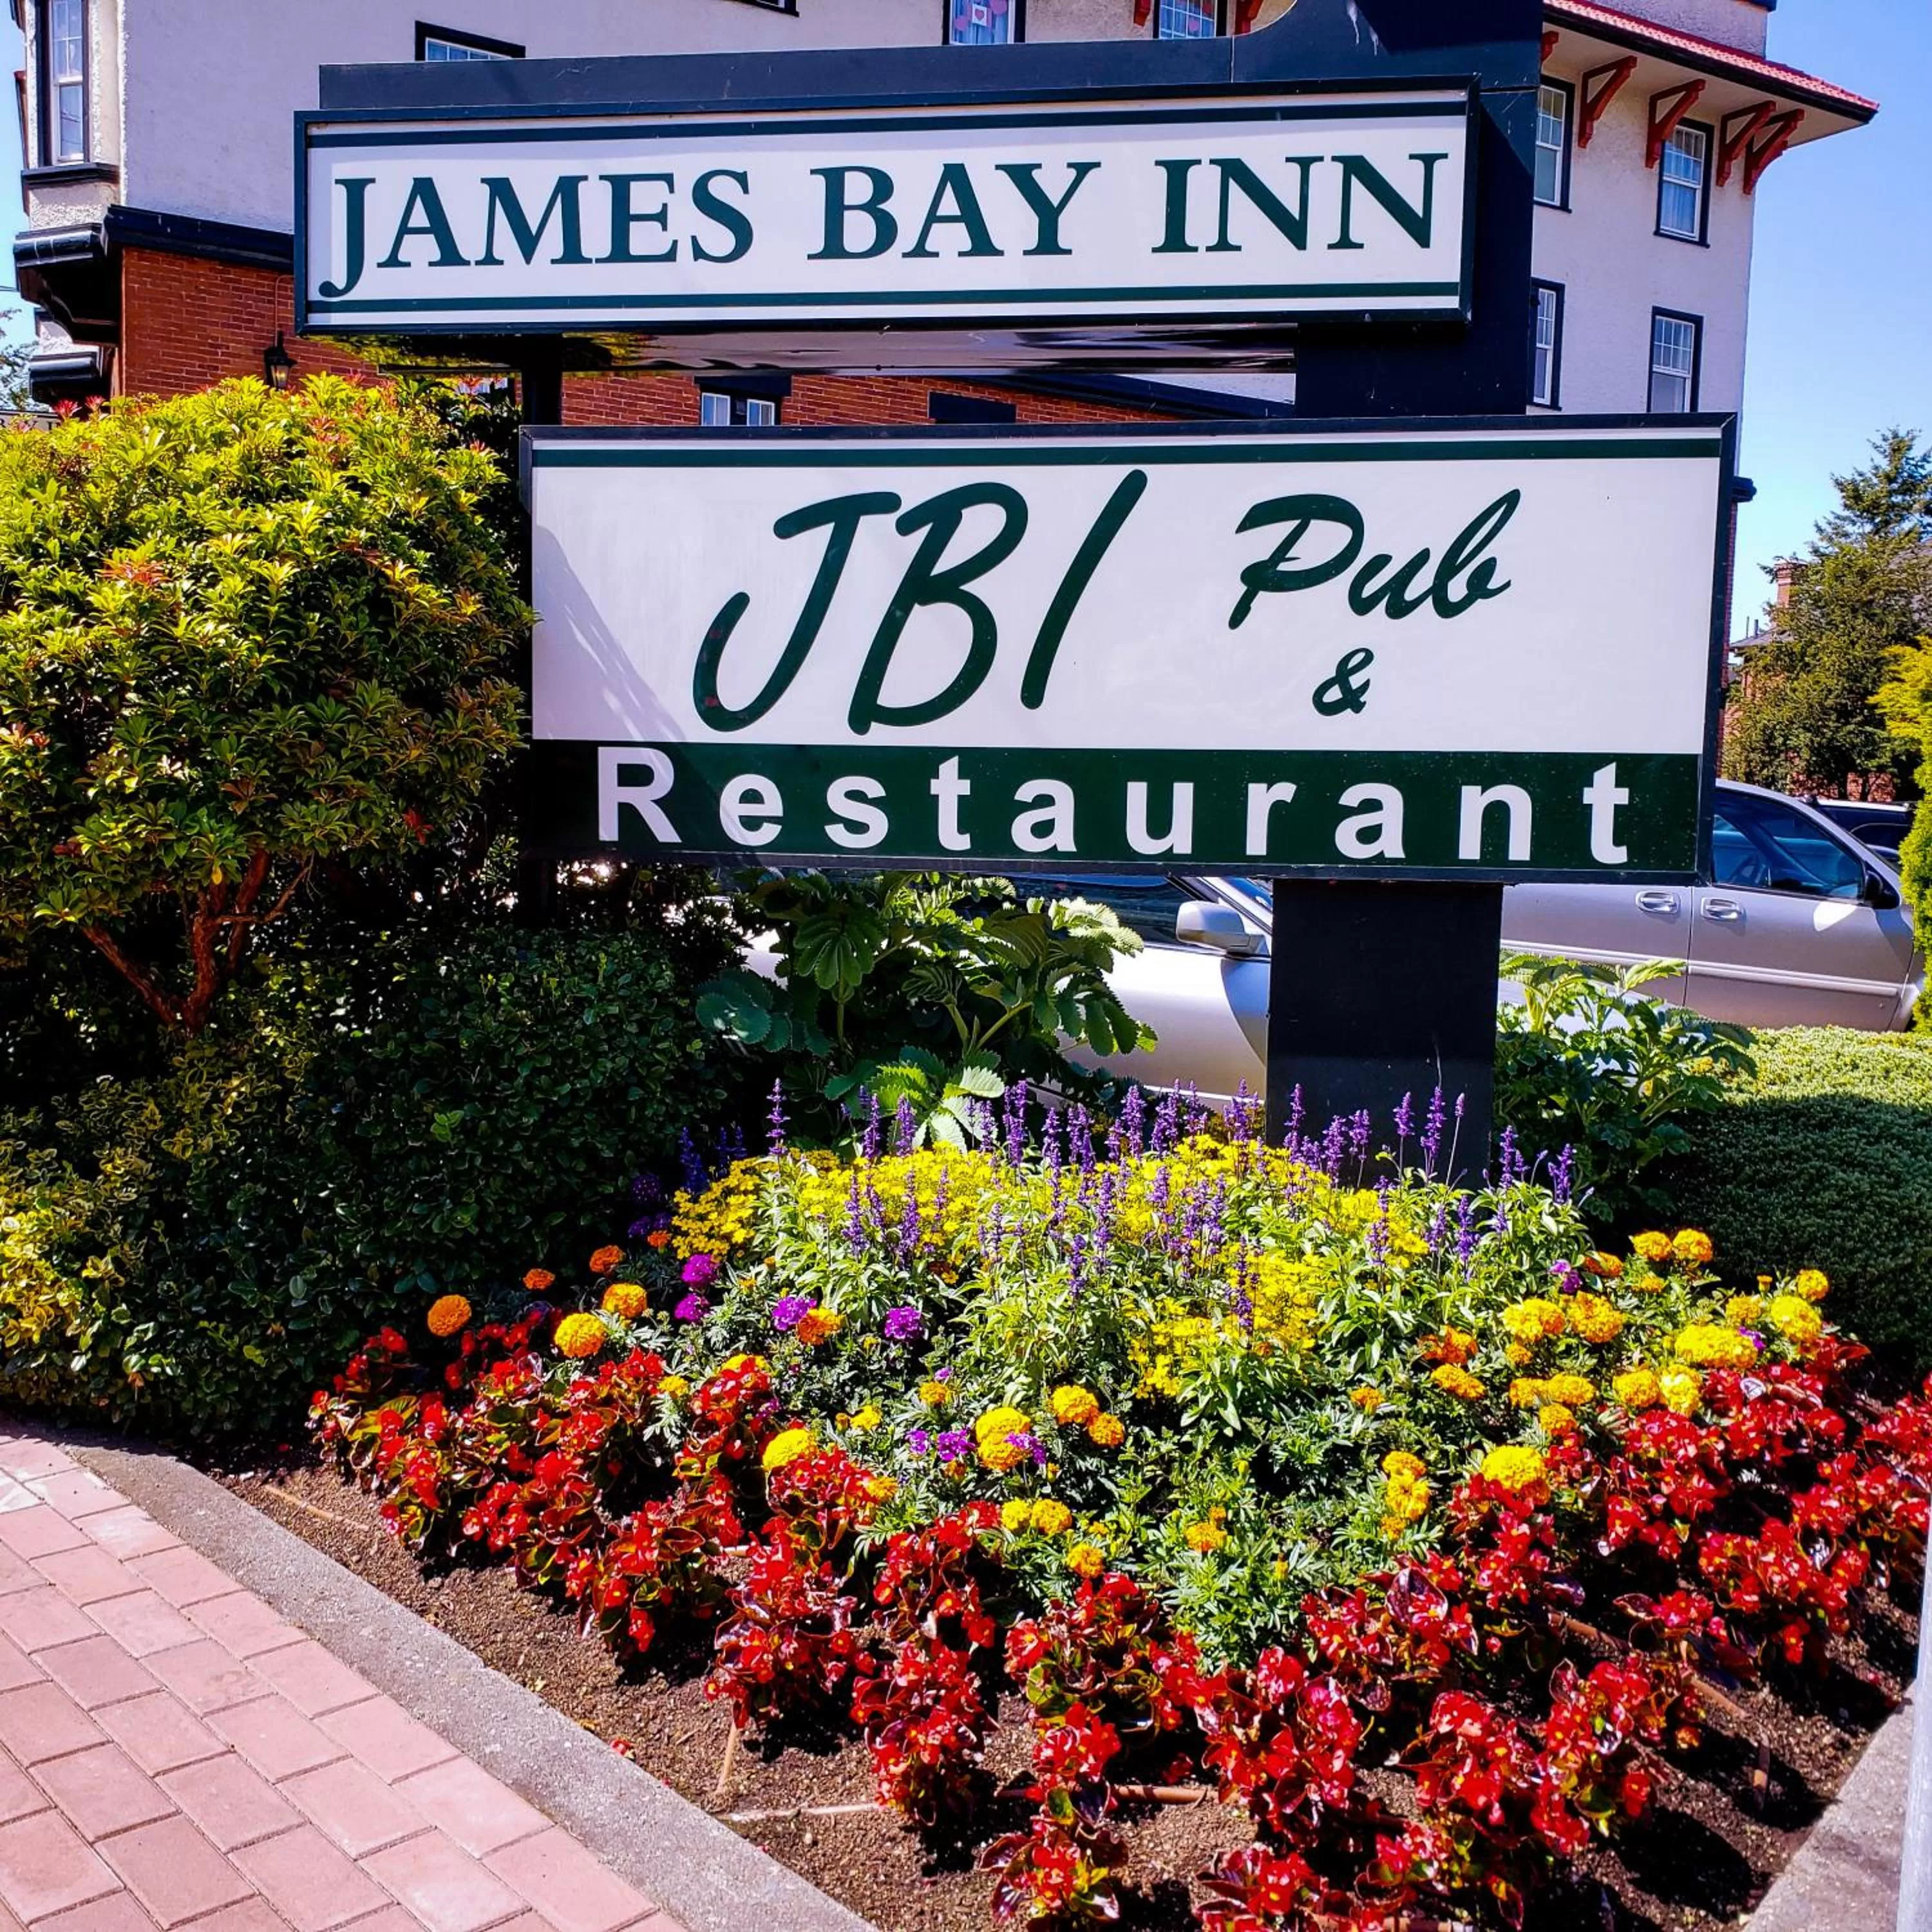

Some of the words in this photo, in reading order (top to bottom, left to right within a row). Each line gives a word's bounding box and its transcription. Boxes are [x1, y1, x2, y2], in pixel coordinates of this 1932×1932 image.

[318, 169, 754, 298] JAMES
[807, 161, 1102, 260] BAY
[1150, 153, 1448, 254] INN
[692, 469, 1148, 735] JBI
[1227, 488, 1521, 630] Pub
[1311, 647, 1375, 717] &
[597, 746, 1630, 865] Restaurant
